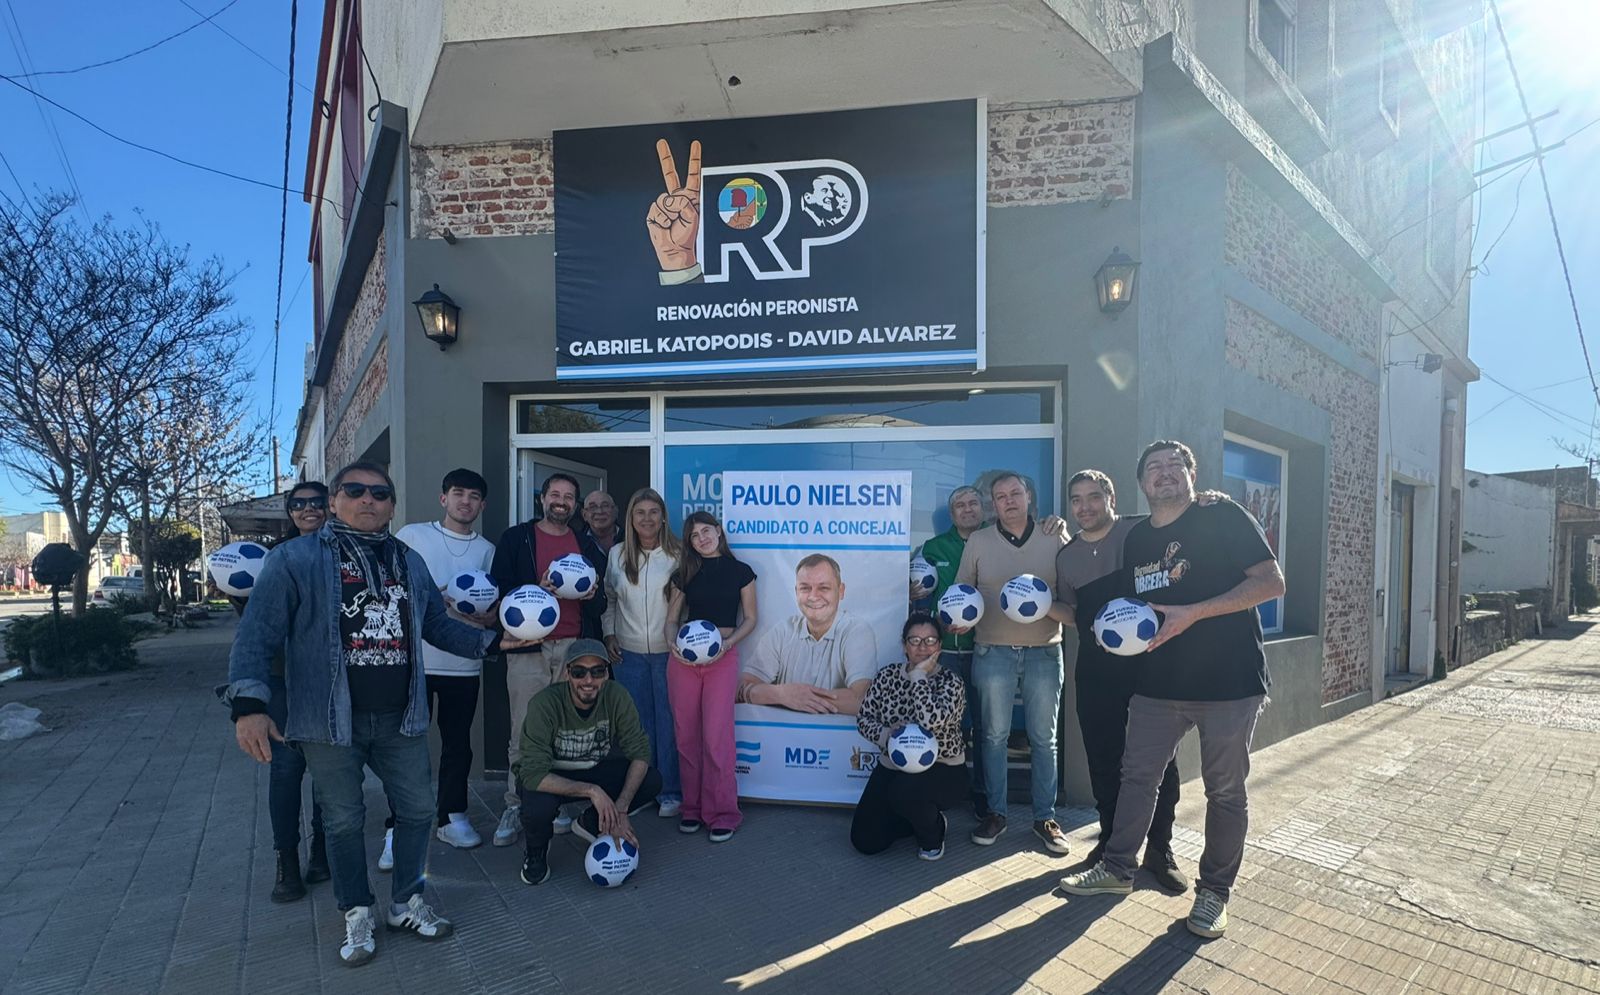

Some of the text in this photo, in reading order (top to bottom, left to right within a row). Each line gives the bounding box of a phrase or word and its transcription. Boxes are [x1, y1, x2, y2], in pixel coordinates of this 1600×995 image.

[656, 296, 859, 322] RENOVACIÓN PERONISTA
[569, 336, 653, 358] GABRIEL
[657, 332, 773, 354] KATOPODIS
[788, 328, 854, 348] DAVID
[857, 324, 957, 345] ALVAREZ
[731, 484, 902, 506] PAULO NIELSEN
[726, 519, 907, 536] CANDIDATO A CONCEJAL
[219, 552, 241, 560] FUERZA
[1135, 570, 1170, 594] OBRERA
[1115, 605, 1138, 613] FUERZA
[1117, 610, 1138, 618] PATRIA
